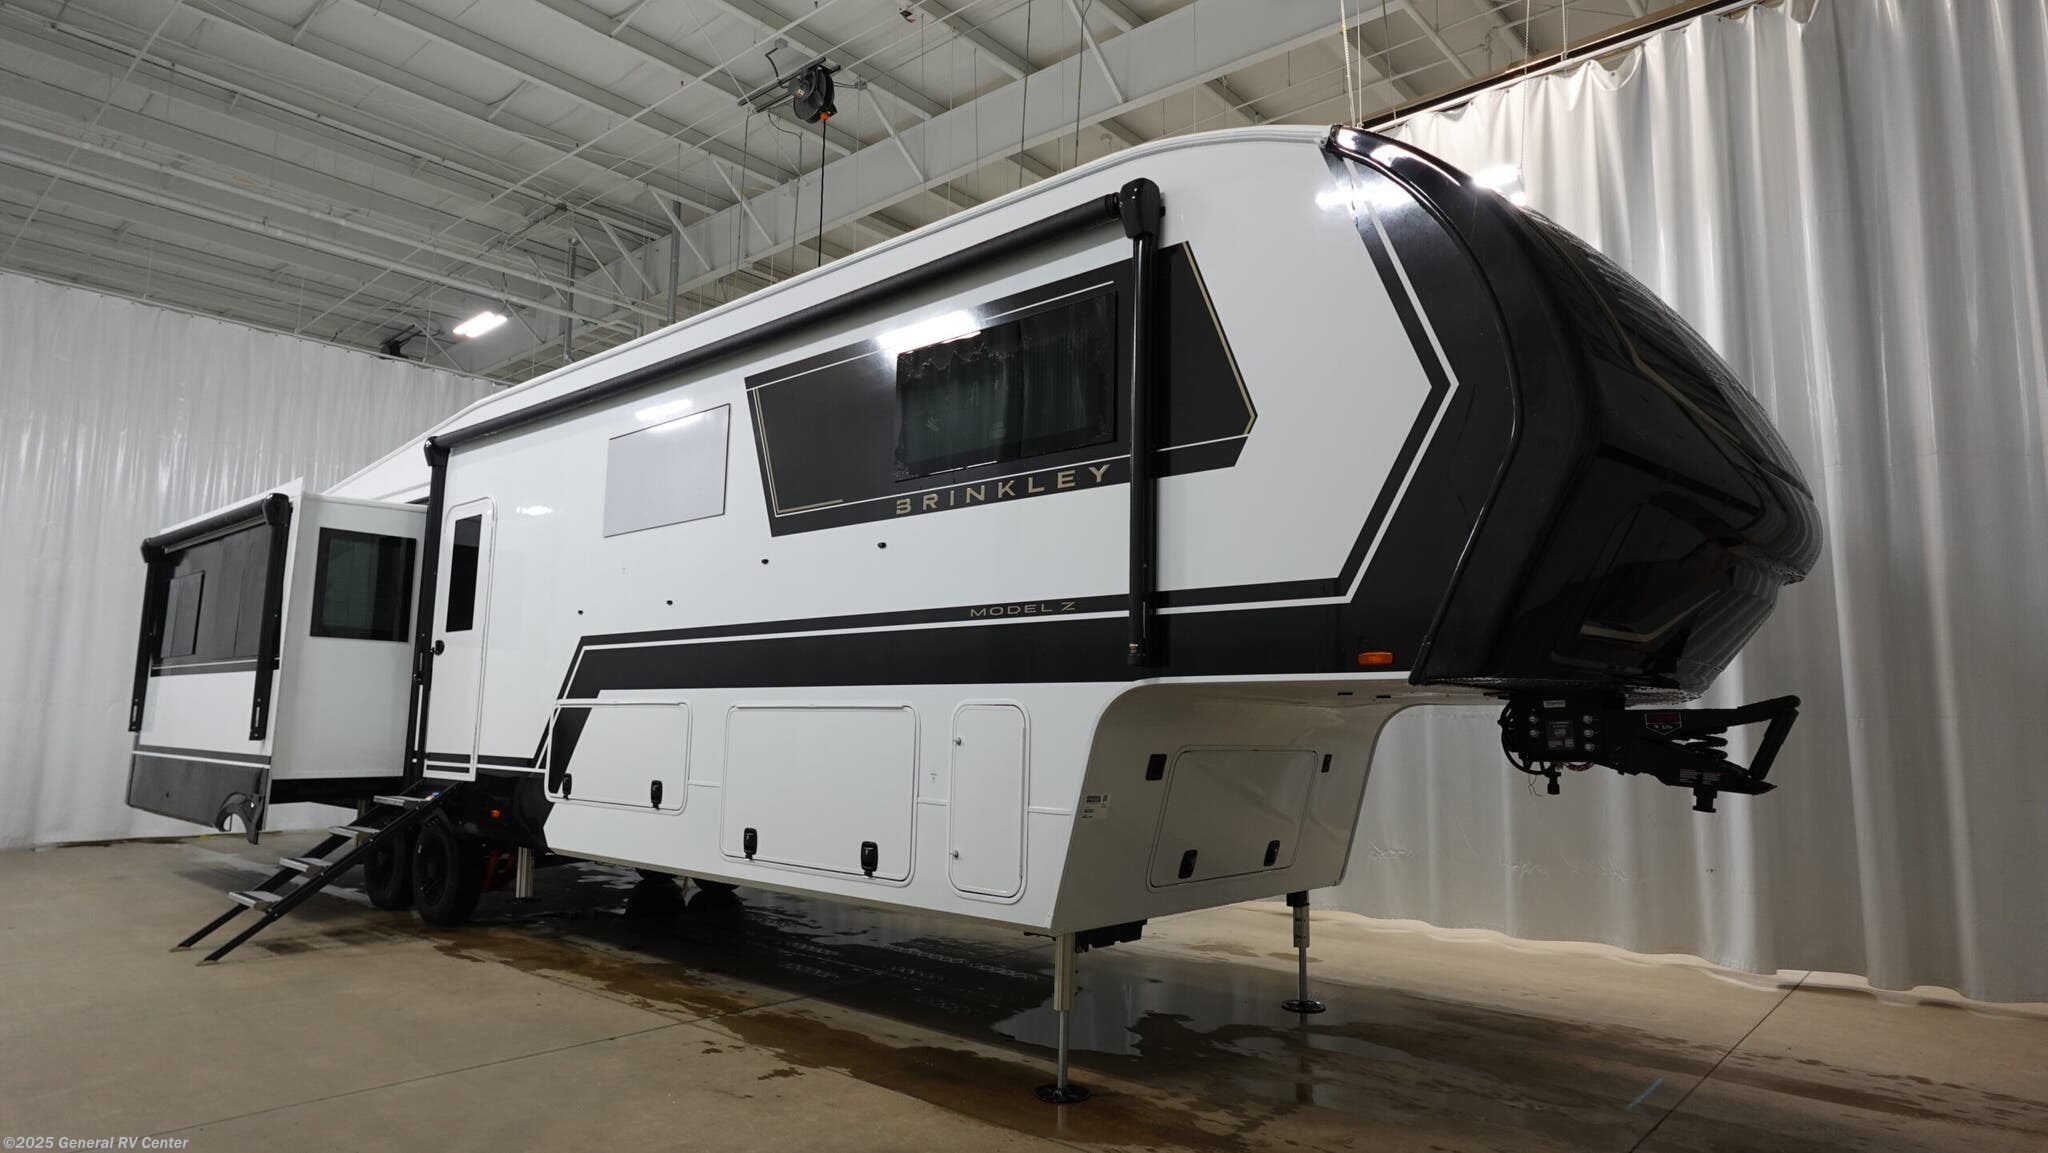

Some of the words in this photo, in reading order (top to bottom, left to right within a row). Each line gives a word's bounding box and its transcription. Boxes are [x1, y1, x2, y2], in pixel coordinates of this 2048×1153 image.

[896, 464, 1110, 515] BRINKLEY
[970, 603, 1052, 617] MODEL
[1061, 601, 1076, 611] Z
